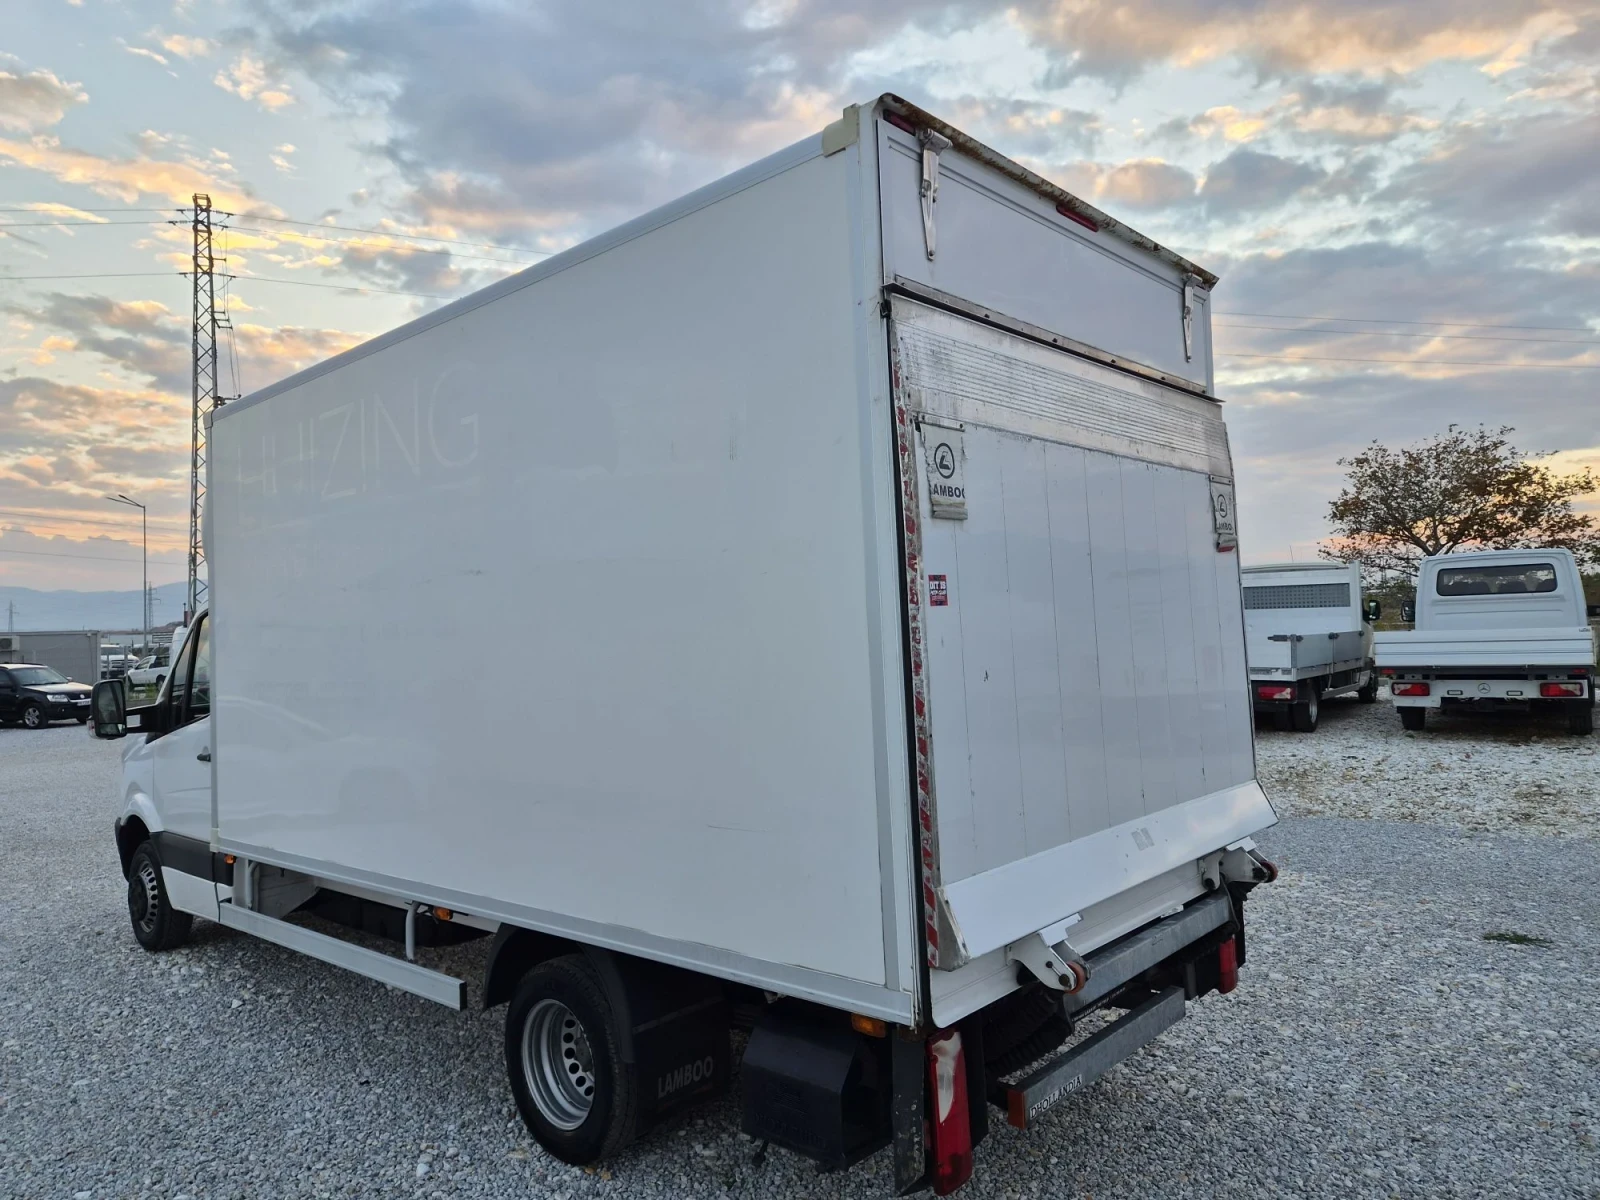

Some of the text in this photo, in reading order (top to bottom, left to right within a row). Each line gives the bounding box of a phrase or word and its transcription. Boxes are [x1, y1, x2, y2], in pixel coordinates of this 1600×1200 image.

[933, 483, 965, 499] AMBO
[657, 1055, 713, 1100] LAMBOO
[1030, 1075, 1082, 1119] DHOLLANDIA
